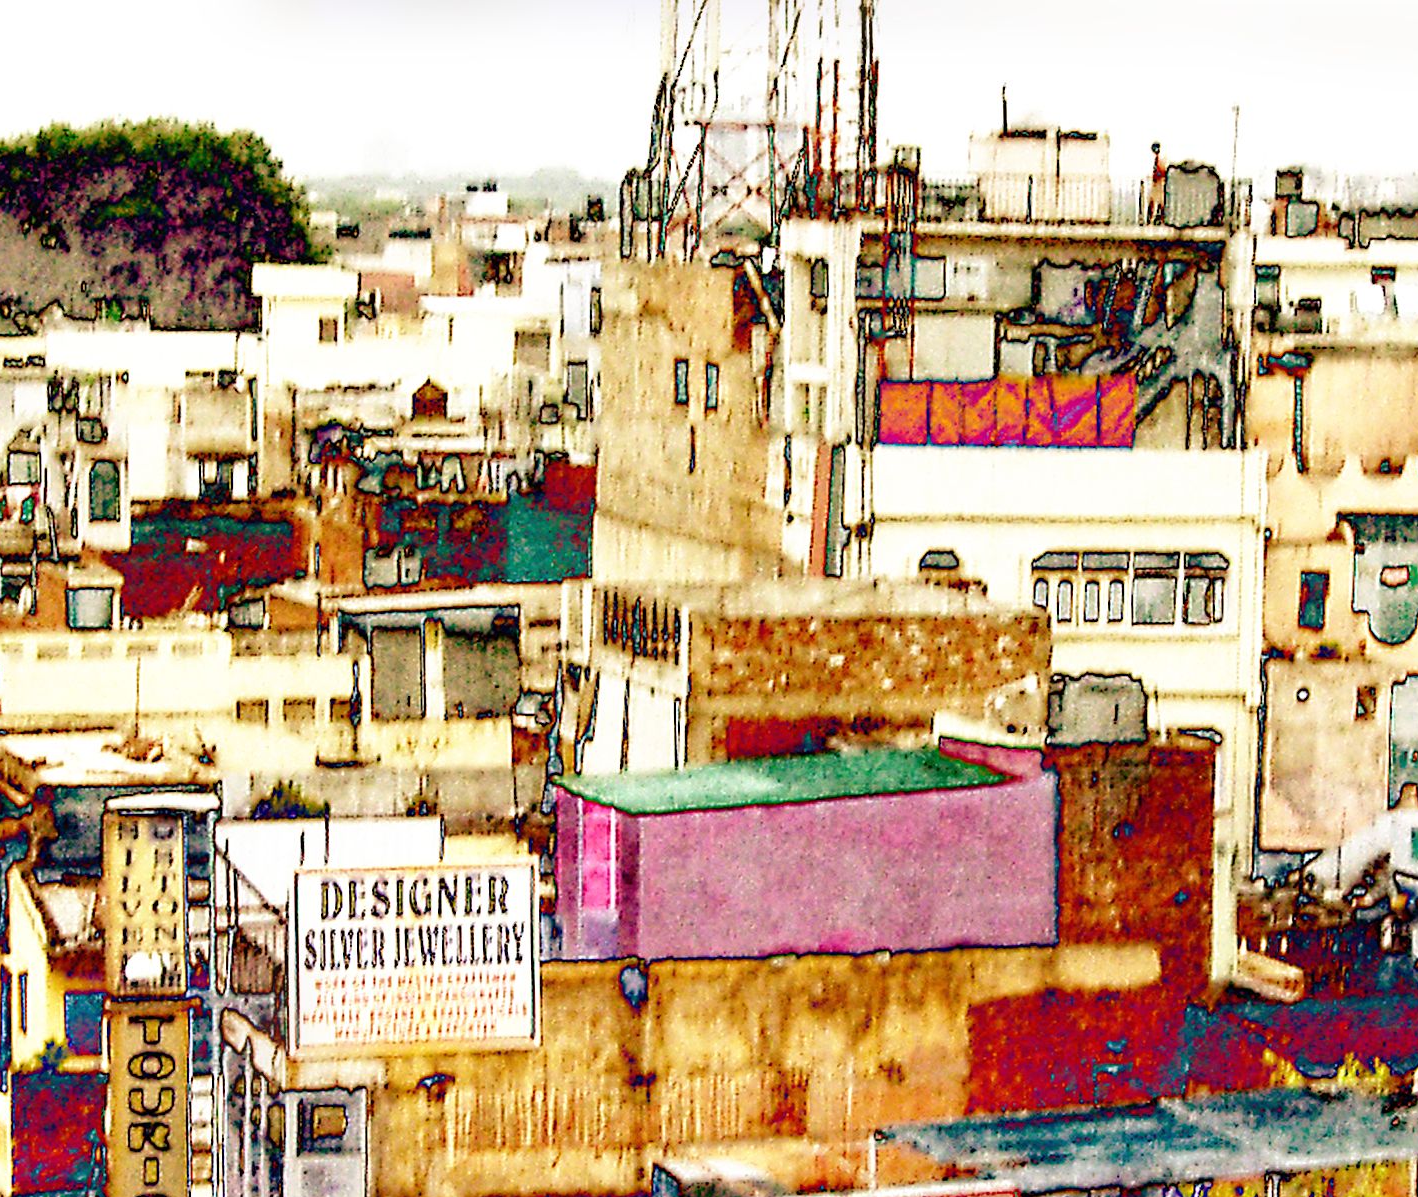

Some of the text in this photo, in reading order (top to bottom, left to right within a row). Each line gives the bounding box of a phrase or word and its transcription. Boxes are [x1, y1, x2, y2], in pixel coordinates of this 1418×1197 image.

[320, 875, 509, 920] DESIGNER
[304, 921, 525, 971] SILVER JEWELLERY
